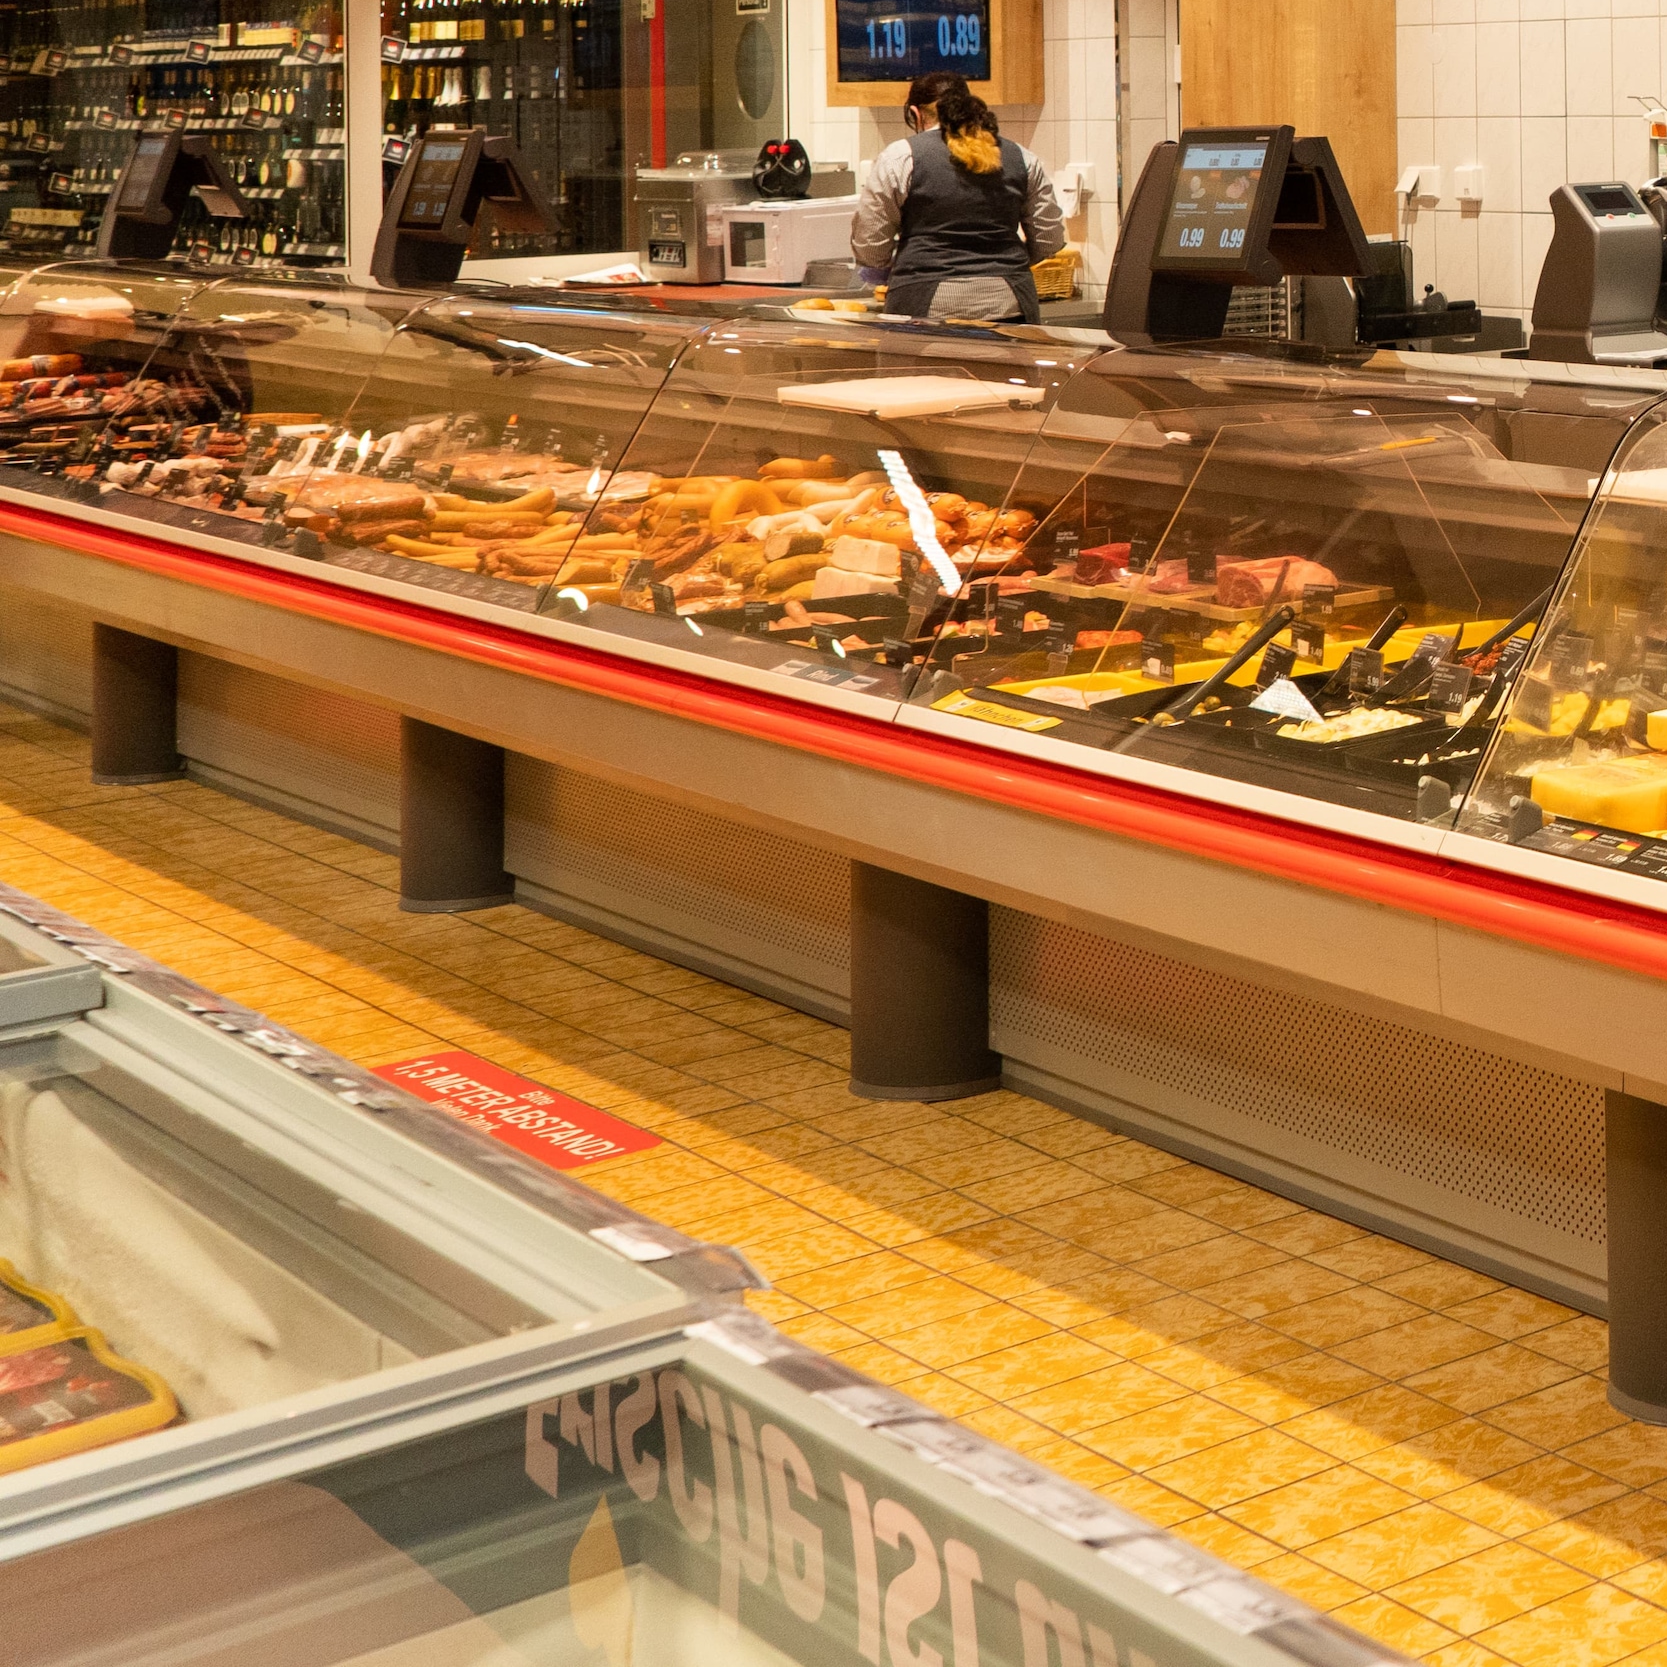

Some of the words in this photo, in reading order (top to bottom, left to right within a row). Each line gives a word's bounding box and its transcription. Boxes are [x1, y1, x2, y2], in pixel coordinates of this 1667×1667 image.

[866, 17, 906, 59] 1.19
[937, 14, 981, 57] 0.89
[1180, 228, 1204, 248] 0.99
[1220, 229, 1245, 249] 0.99
[806, 669, 839, 683] Rind
[518, 1089, 556, 1107] Bitte
[396, 1060, 449, 1084] 1,5
[425, 1072, 516, 1111] METER
[499, 1103, 626, 1161] ABSTAND!
